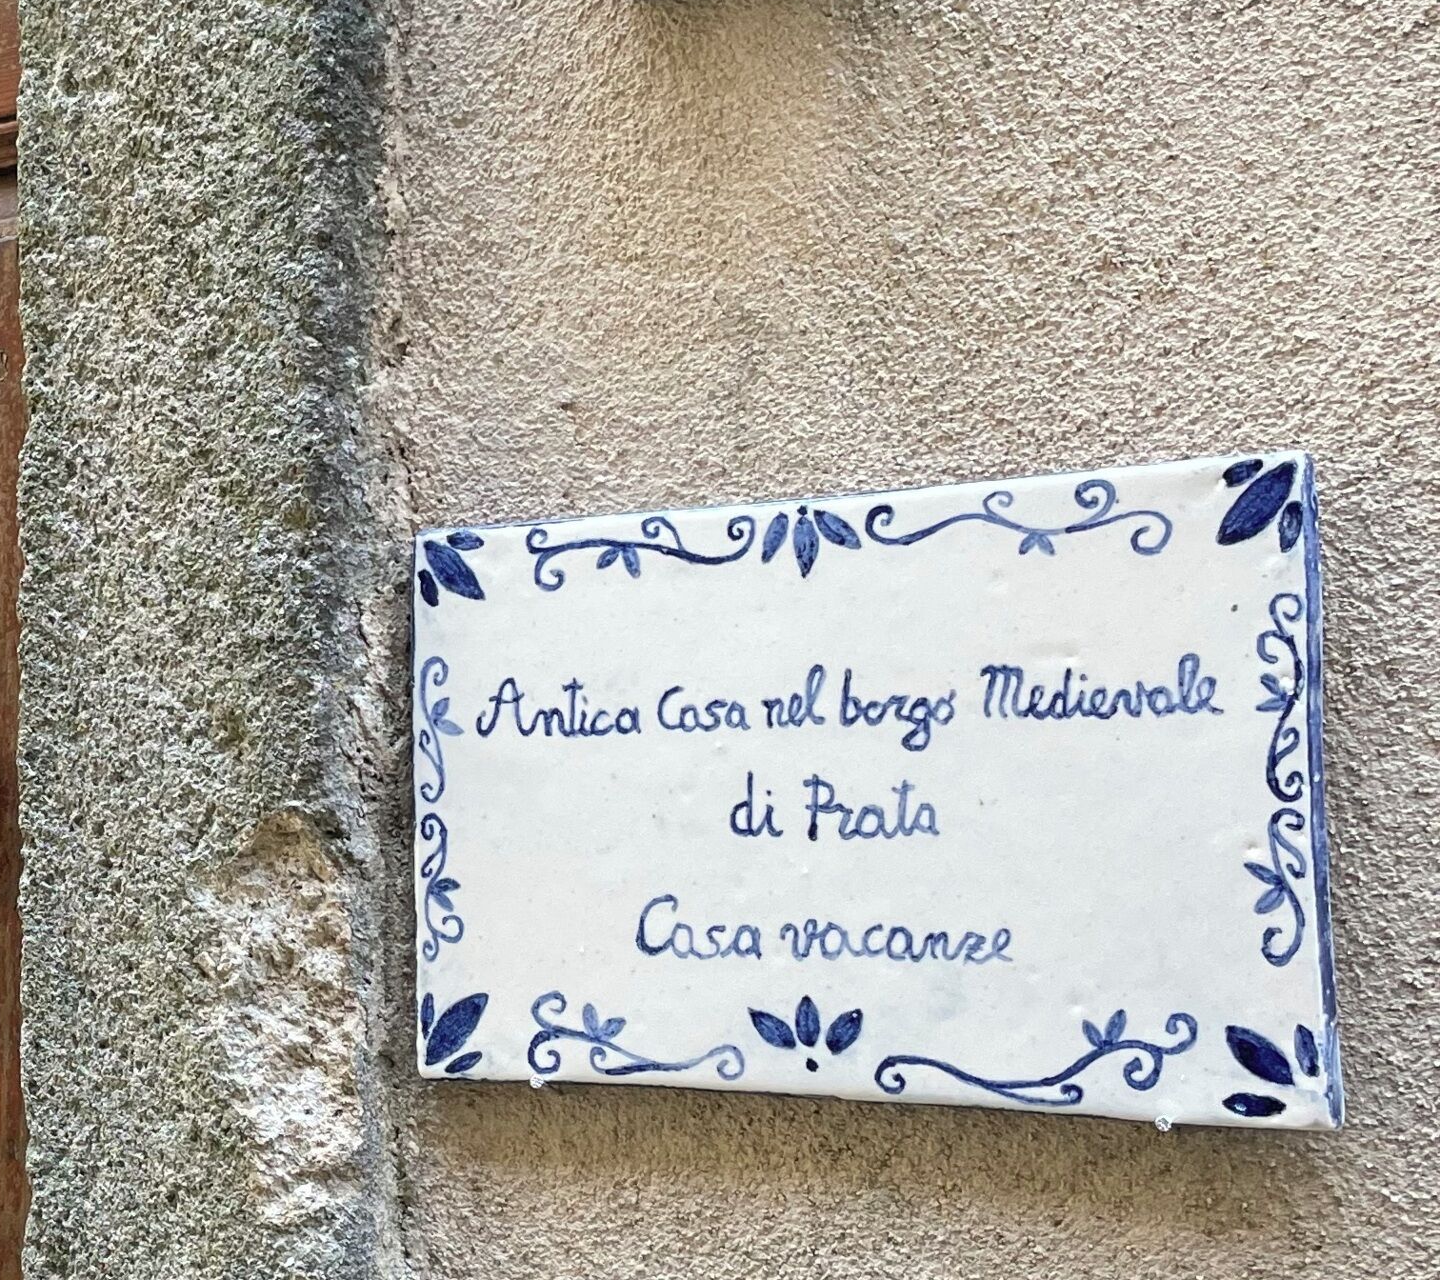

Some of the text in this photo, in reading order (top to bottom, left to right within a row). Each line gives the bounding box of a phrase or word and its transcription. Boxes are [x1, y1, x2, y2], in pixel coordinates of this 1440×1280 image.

[476, 652, 1224, 752] Antica Casa nel borgo Medievale
[730, 770, 940, 841] di Prata
[635, 893, 1013, 963] Casa vacanze
